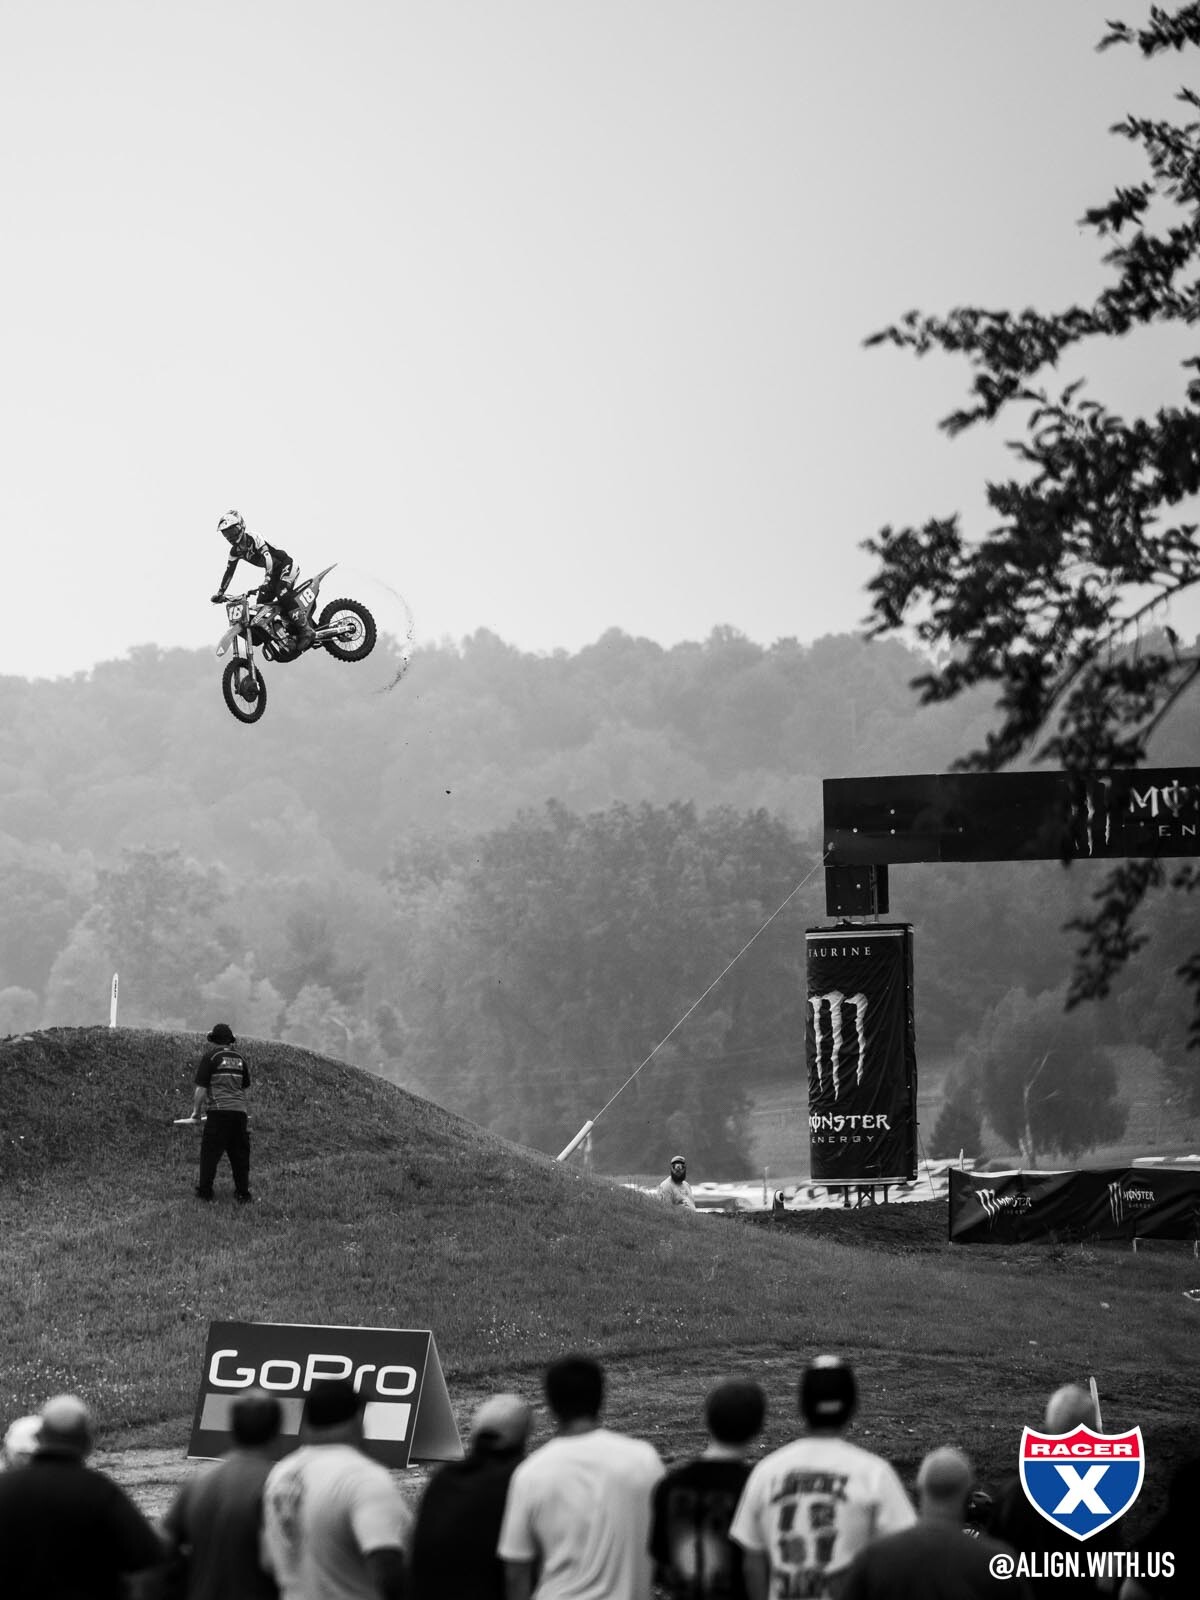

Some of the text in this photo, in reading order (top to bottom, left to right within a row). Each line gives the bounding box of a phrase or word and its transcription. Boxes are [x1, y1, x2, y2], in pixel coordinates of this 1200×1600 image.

[1129, 780, 1200, 818] MO
[808, 946, 872, 958] TAURINE
[208, 1349, 418, 1397] GoPro
